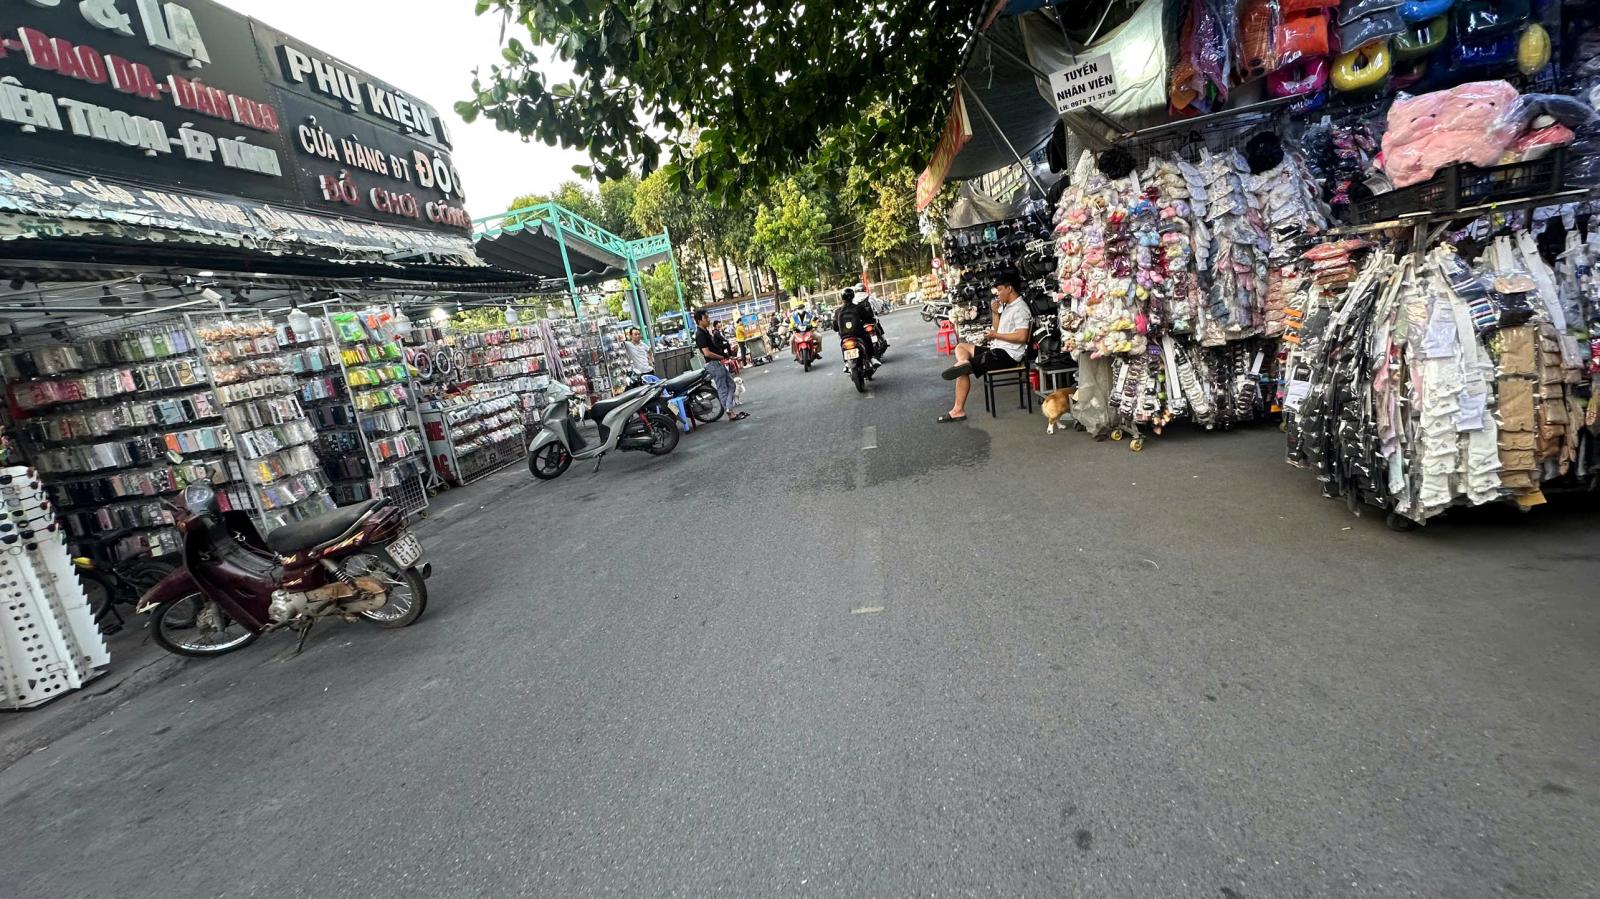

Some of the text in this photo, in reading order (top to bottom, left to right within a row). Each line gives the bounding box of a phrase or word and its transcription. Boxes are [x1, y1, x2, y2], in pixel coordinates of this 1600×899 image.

[1064, 61, 1098, 82] TUYỂN
[283, 45, 362, 112] PHỤ
[366, 82, 433, 136] KIỆN
[1056, 74, 1113, 101] NHÂN VIÊN
[1070, 99, 1087, 108] 0974
[1088, 95, 1096, 103] 71
[299, 115, 340, 162] CỬA
[340, 133, 389, 176] HÀNG
[389, 153, 411, 182] ĐT
